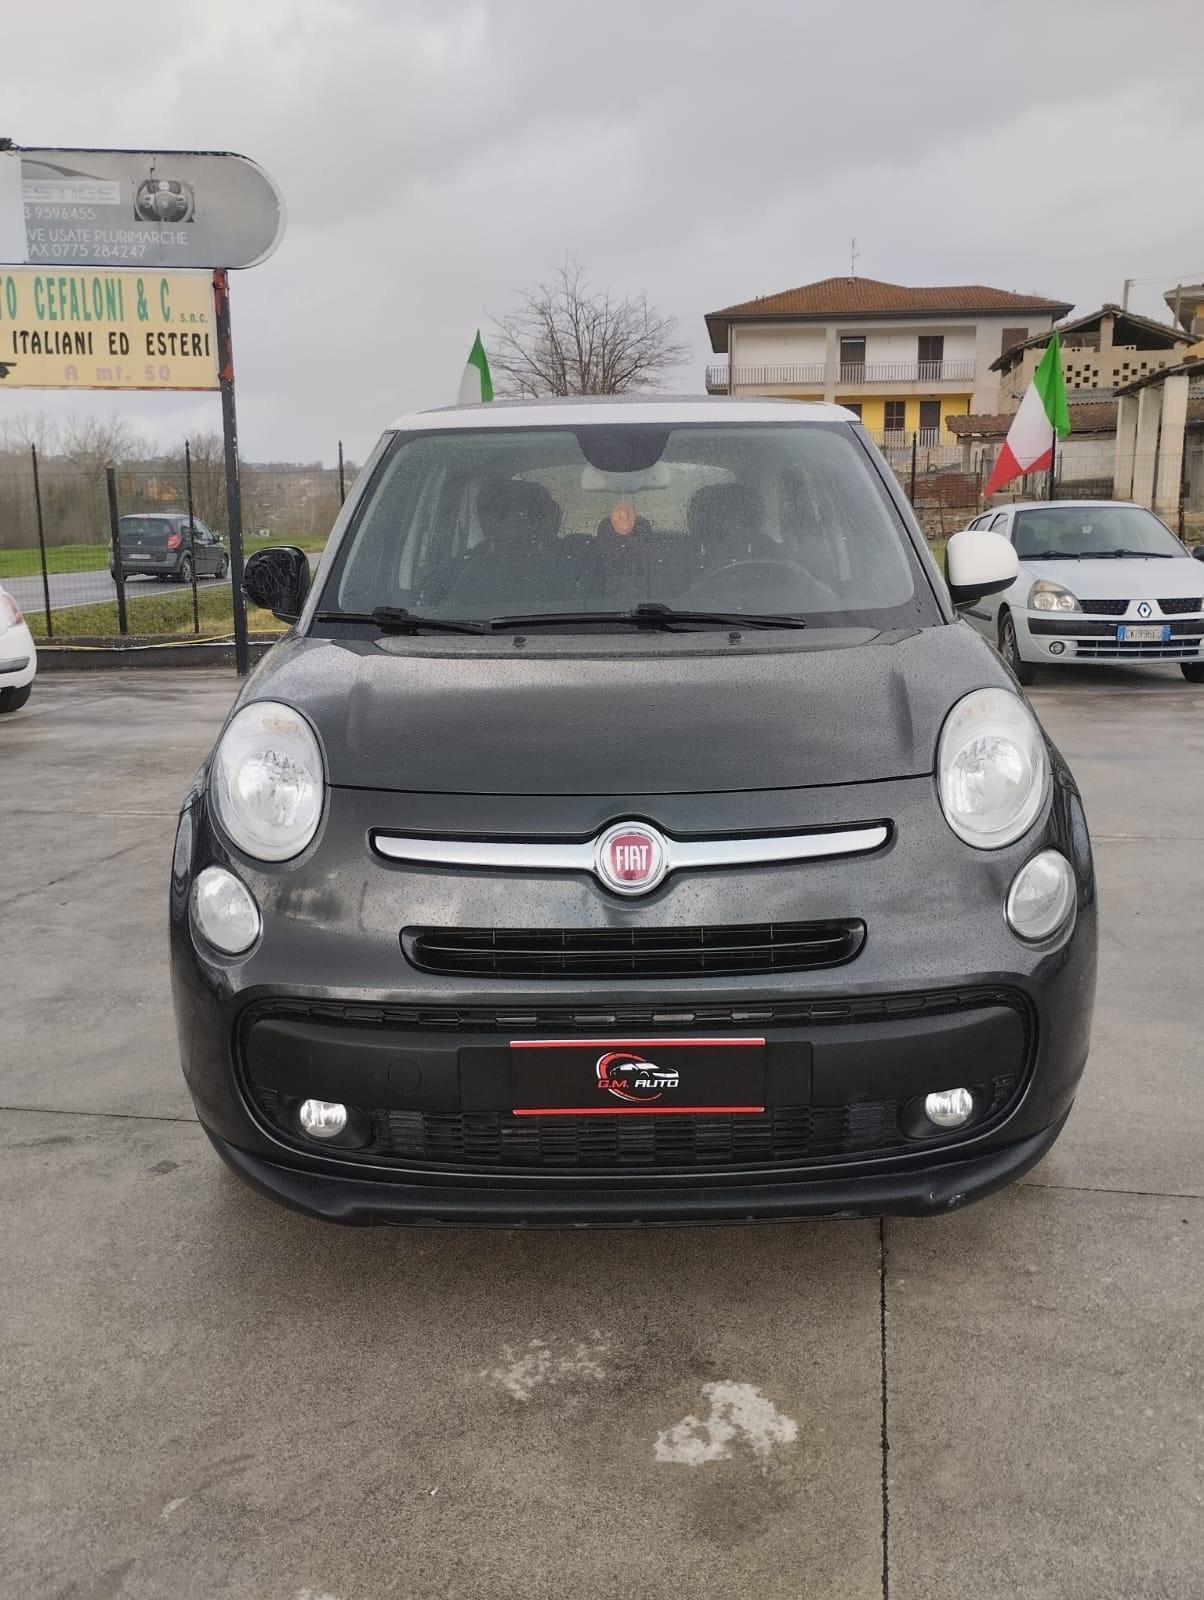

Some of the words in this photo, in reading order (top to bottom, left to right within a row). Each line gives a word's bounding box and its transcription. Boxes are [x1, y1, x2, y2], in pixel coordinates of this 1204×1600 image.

[35, 206, 96, 220] 9596455
[49, 228, 91, 242] USATE
[94, 229, 188, 246] PLURIMARCHE
[52, 243, 89, 257] 0775
[93, 244, 146, 258] 284247
[0, 275, 17, 321] O
[34, 275, 124, 322] CEFALONI
[137, 277, 149, 322] &
[12, 330, 93, 356] ITALIANI
[109, 331, 130, 356] ED
[146, 332, 210, 357] ESTERI
[64, 364, 79, 381] A
[145, 365, 171, 382] 50
[615, 845, 649, 871] FIAT
[597, 1079, 629, 1089] G.M.
[634, 1079, 679, 1089] AUTO
